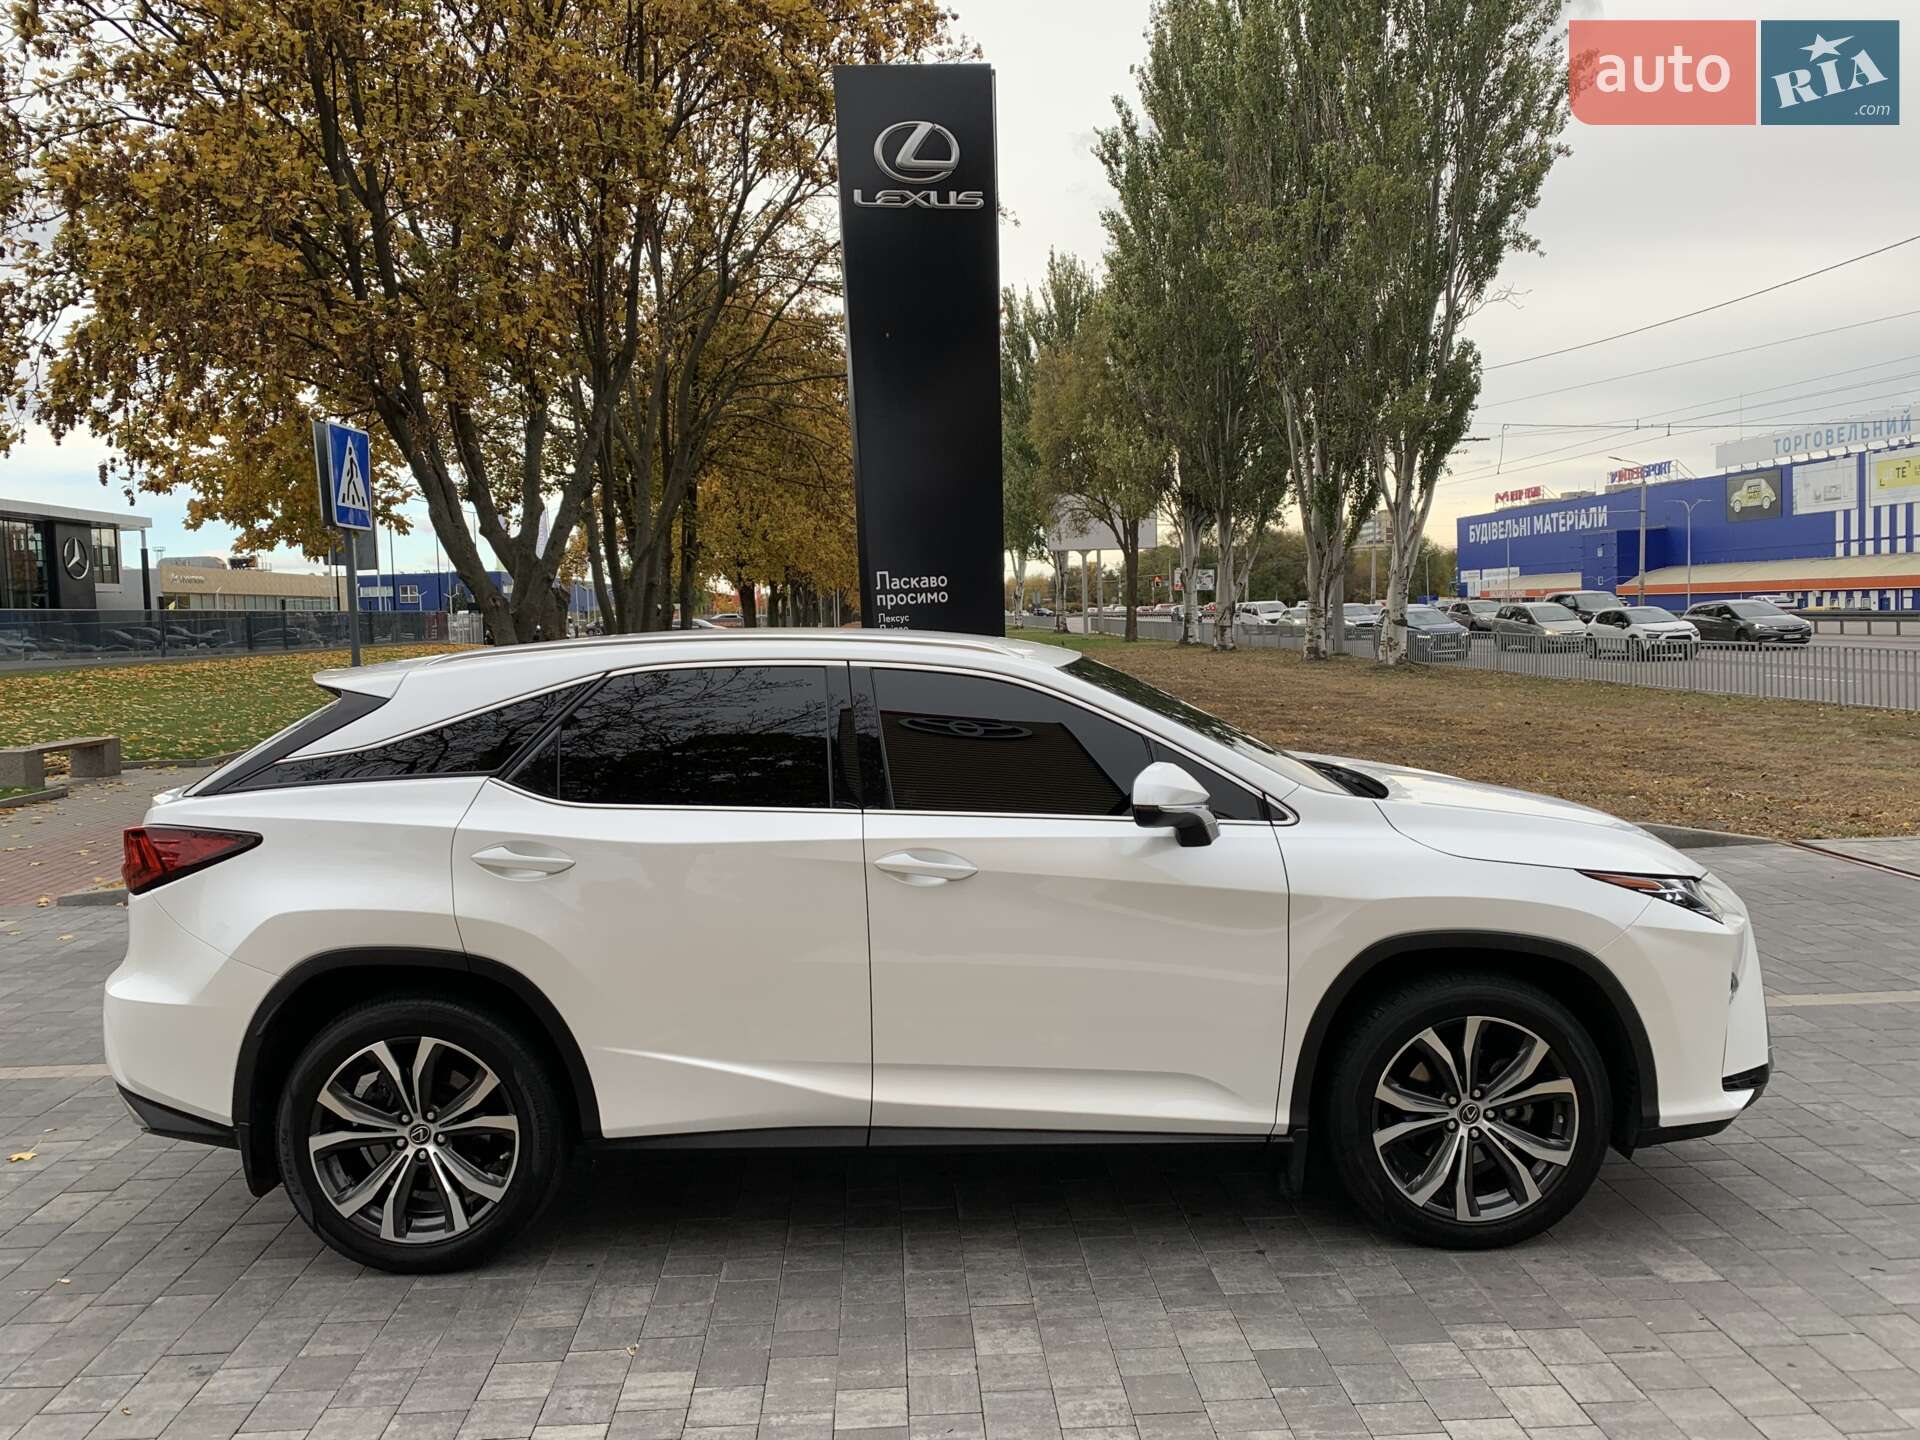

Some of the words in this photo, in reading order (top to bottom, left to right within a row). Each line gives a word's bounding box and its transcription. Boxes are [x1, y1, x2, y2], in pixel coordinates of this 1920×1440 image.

[853, 189, 985, 209] LEXUS
[1774, 409, 1912, 454] ТОРГОВЕЛЬНИЙ
[1468, 515, 1531, 545] БУДІВЕЛЬНІ
[1533, 504, 1608, 535] МАТЕРІАЛИ
[875, 571, 948, 590] Ласкаво
[876, 591, 949, 609] просимо
